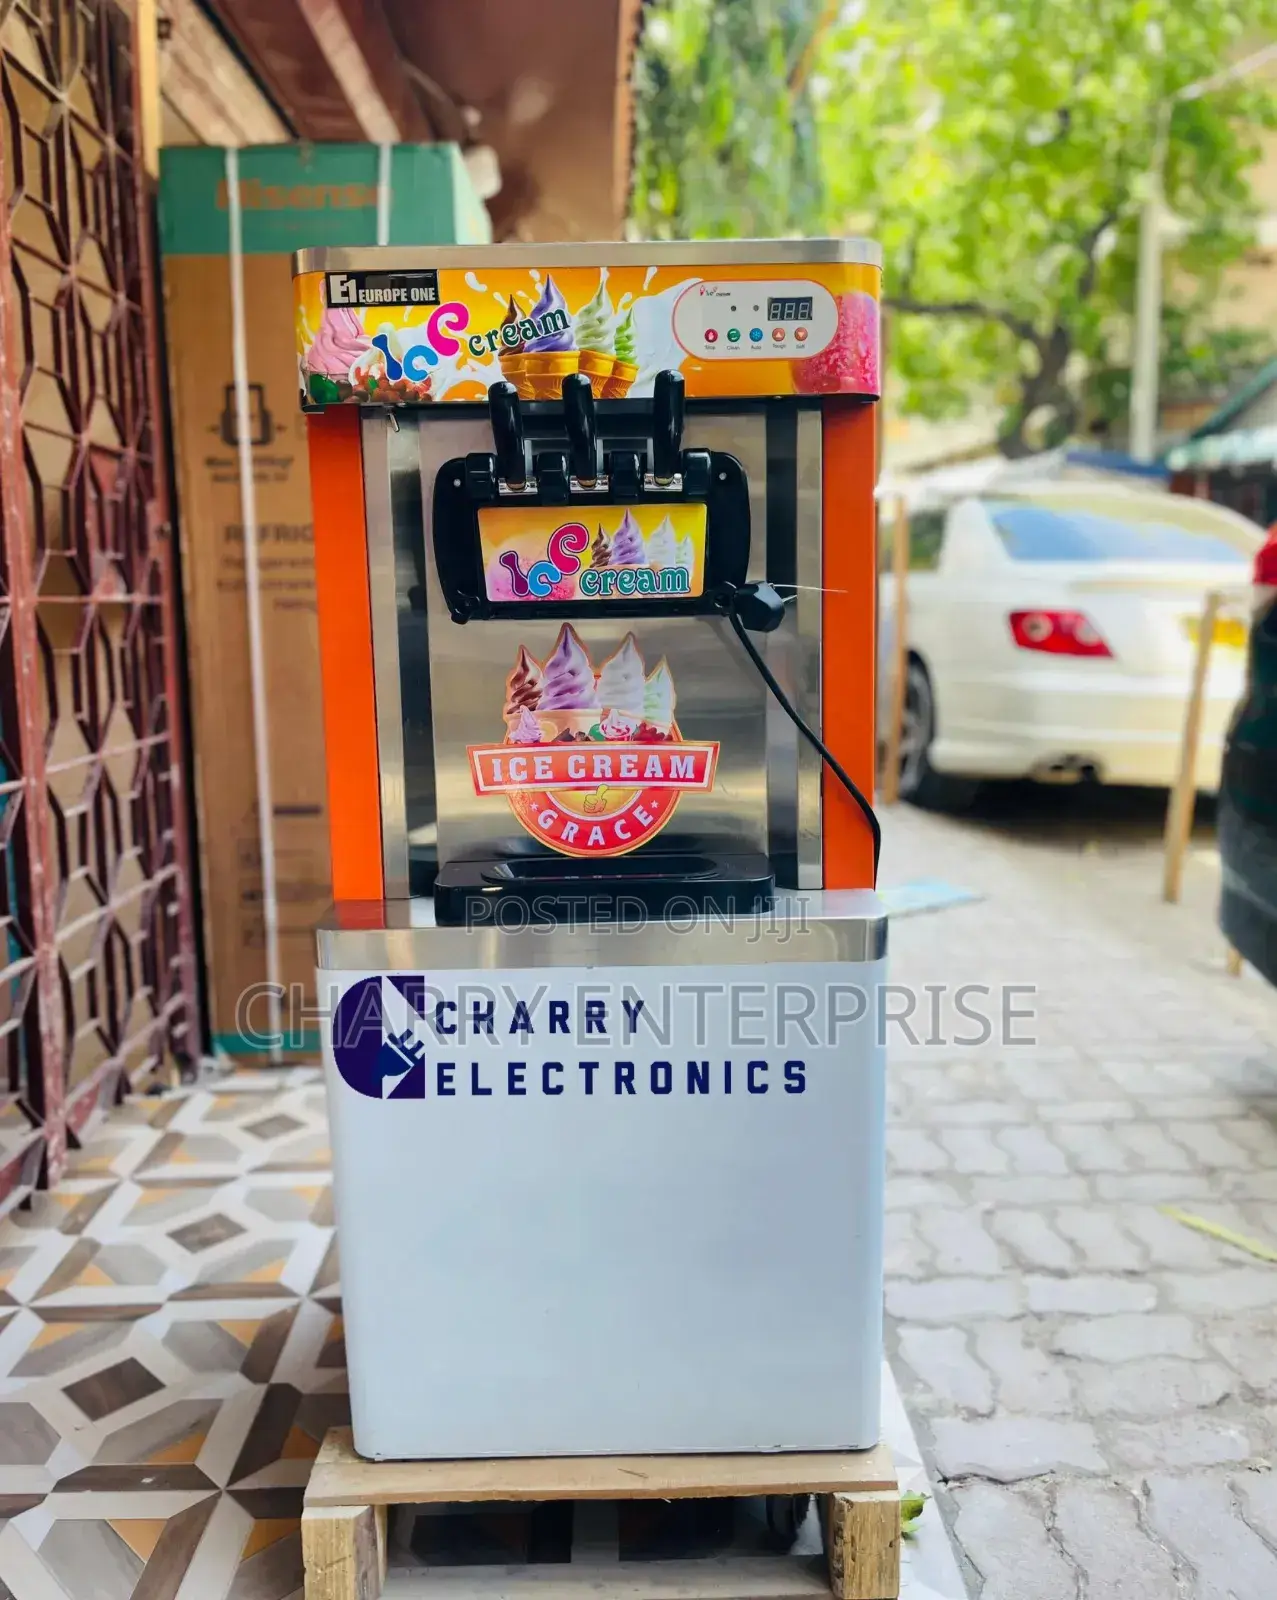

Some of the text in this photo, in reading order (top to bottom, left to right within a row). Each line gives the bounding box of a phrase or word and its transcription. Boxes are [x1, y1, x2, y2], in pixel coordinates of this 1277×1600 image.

[329, 274, 436, 304] E1 EUROPE ONE
[468, 308, 570, 357] cream
[579, 566, 691, 597] cream
[492, 754, 696, 782] ICE CREAM
[537, 805, 654, 847] GRACE
